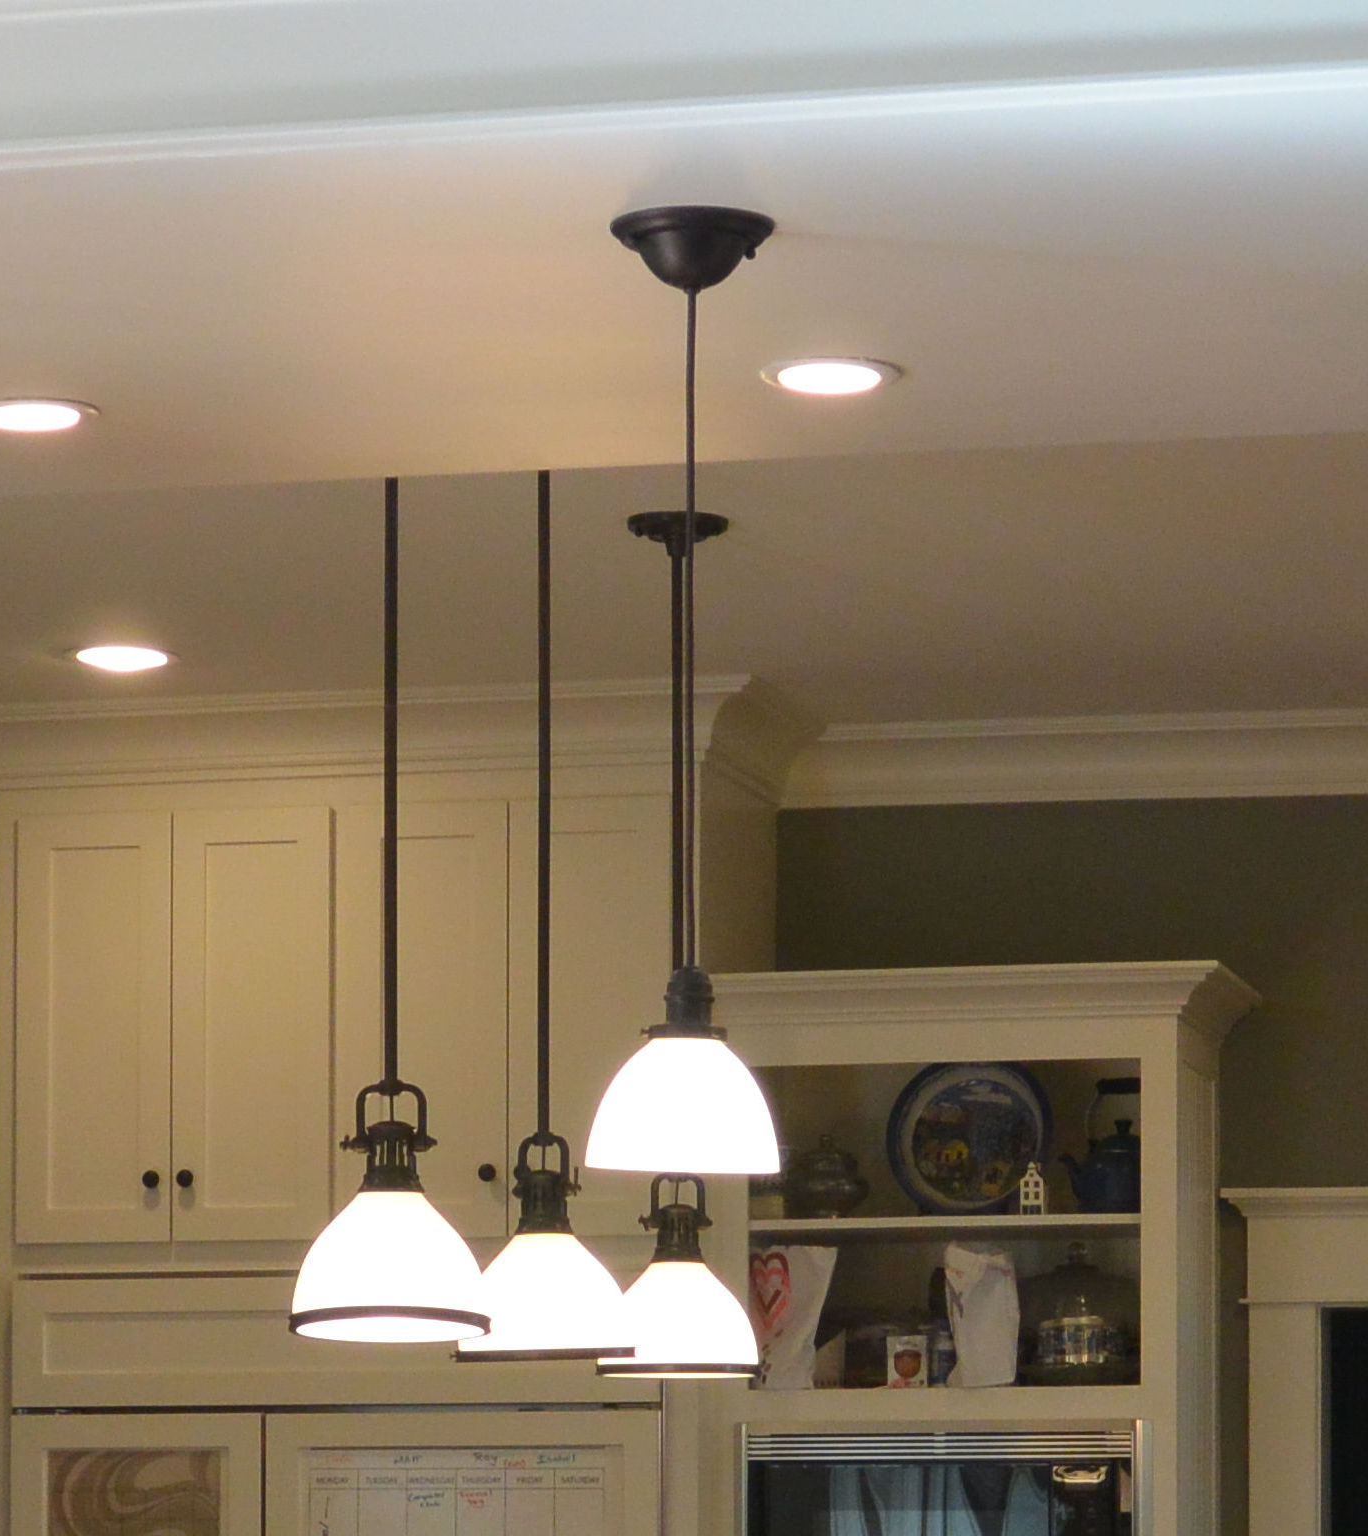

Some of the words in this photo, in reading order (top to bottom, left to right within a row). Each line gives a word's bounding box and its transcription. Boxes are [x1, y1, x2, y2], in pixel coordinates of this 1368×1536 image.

[315, 1476, 349, 1485] MONDAY
[365, 1476, 398, 1485] TUESDAY
[408, 1476, 456, 1485] WEDNESDAY
[461, 1476, 501, 1485] THURSDAY
[516, 1476, 543, 1485] FRIDAY
[561, 1476, 600, 1485] SATURDAY
